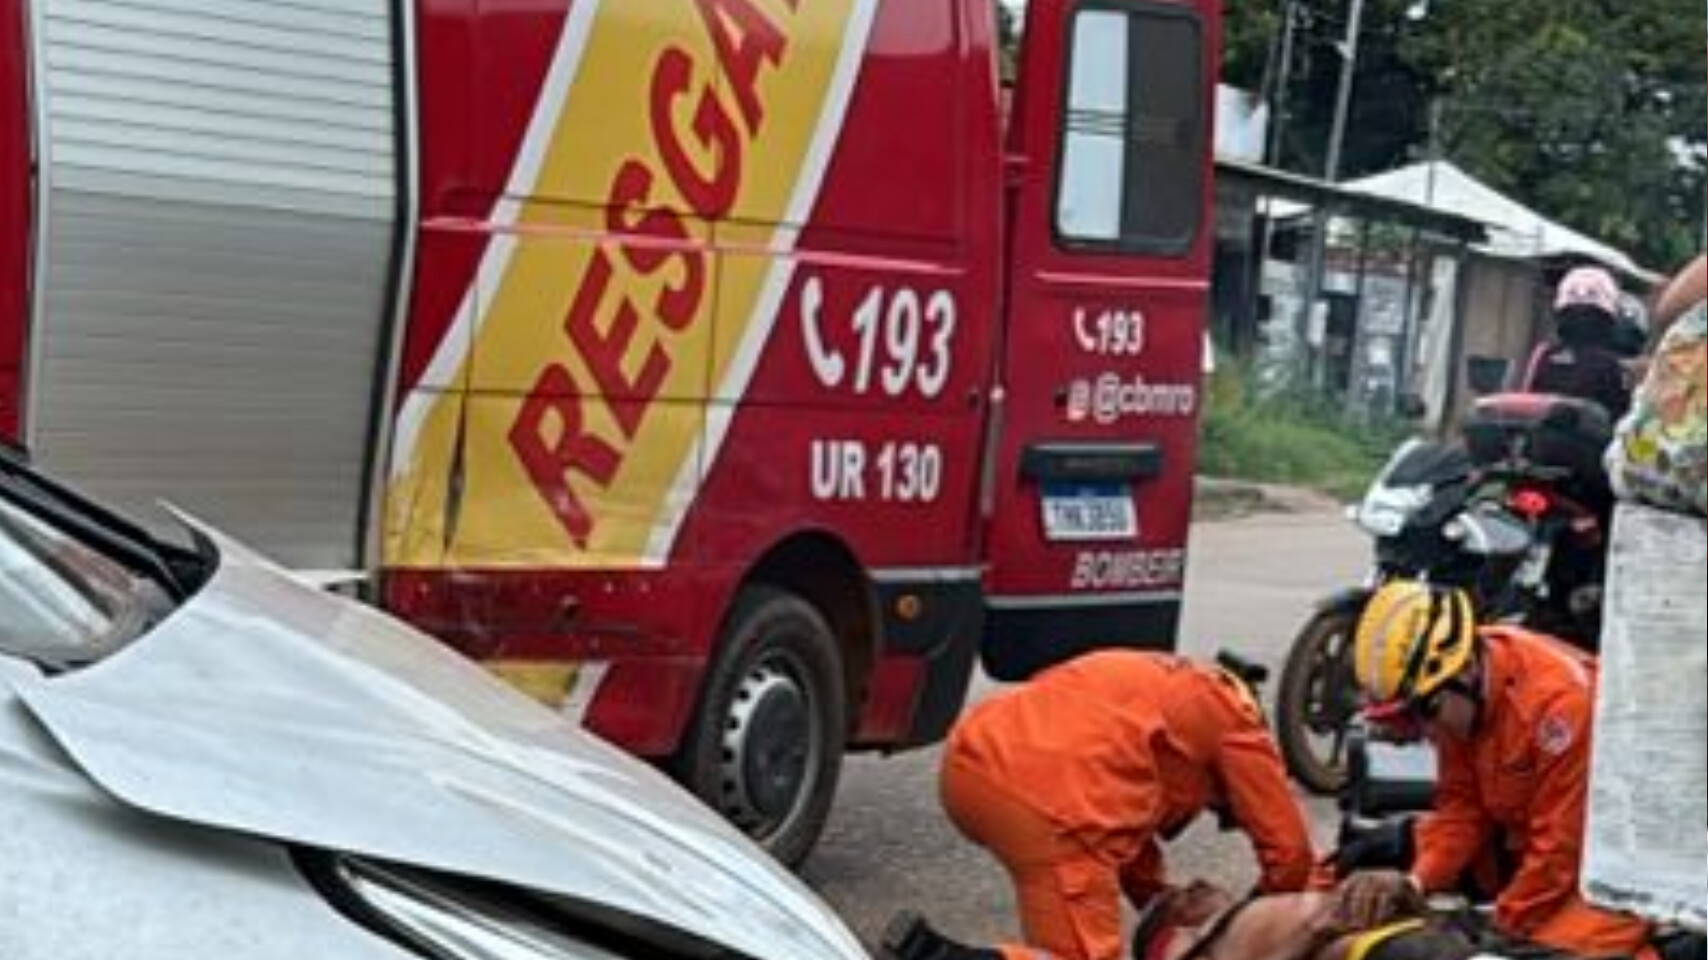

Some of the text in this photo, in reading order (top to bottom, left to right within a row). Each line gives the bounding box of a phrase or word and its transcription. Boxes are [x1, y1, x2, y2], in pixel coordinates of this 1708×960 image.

[507, 0, 798, 552] RESGA
[853, 285, 957, 398] 193
[1097, 310, 1145, 356] 193
[1092, 371, 1195, 424] @cbmro
[812, 441, 942, 502] UR 130
